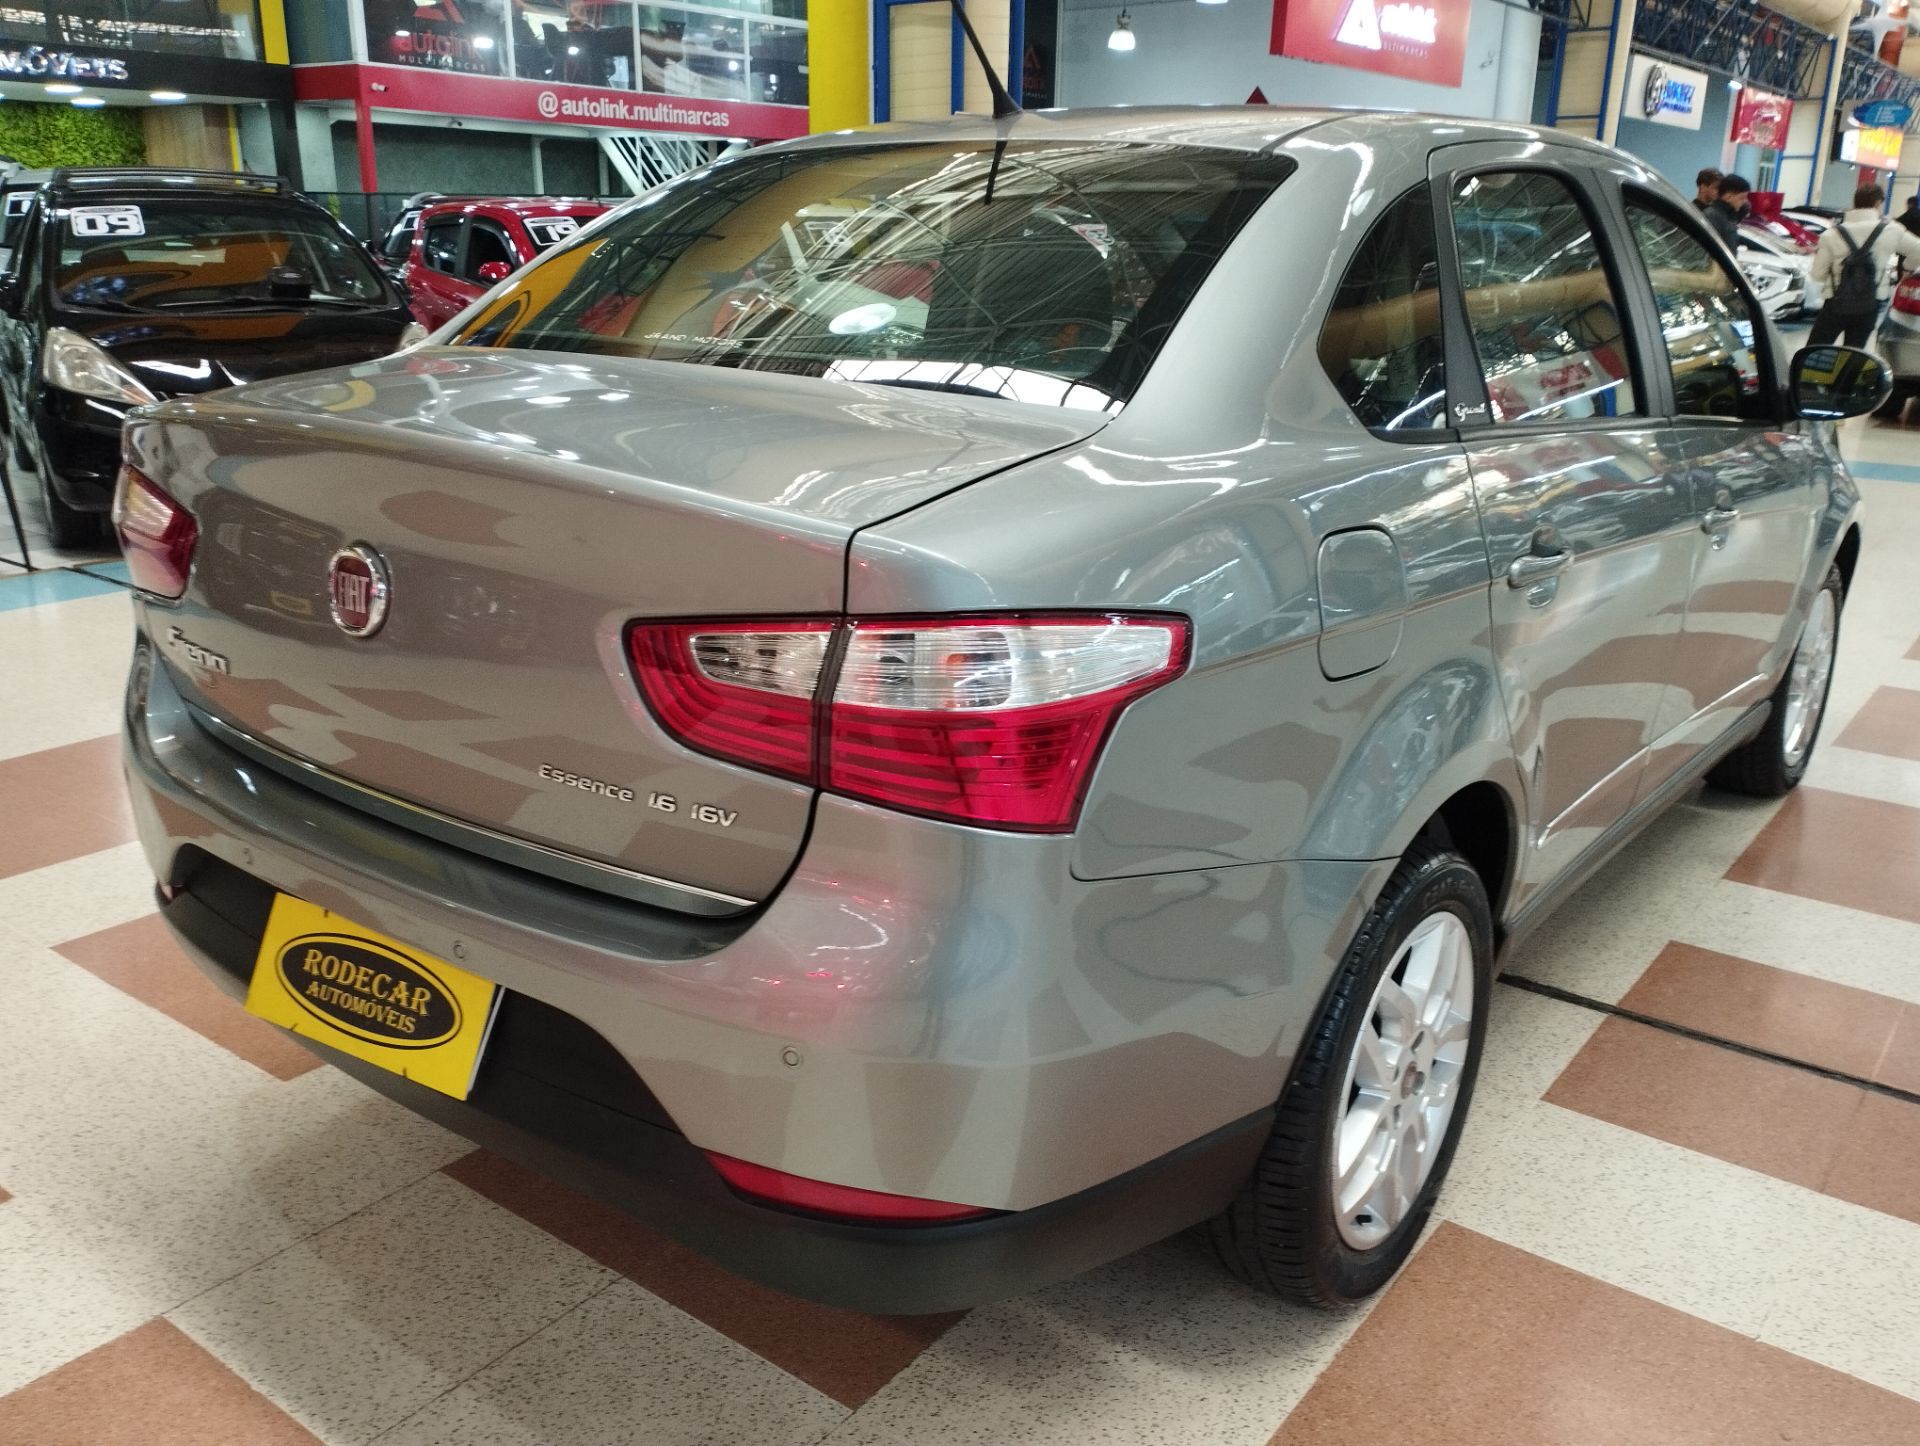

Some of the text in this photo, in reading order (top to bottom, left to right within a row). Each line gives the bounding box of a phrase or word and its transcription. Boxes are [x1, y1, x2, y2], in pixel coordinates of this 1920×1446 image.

[75, 214, 141, 235] 09
[538, 763, 635, 803] Essence
[690, 802, 739, 828] 16V
[302, 948, 432, 1017] RODECAR
[305, 980, 417, 1034] AUTOMÓVEIS
